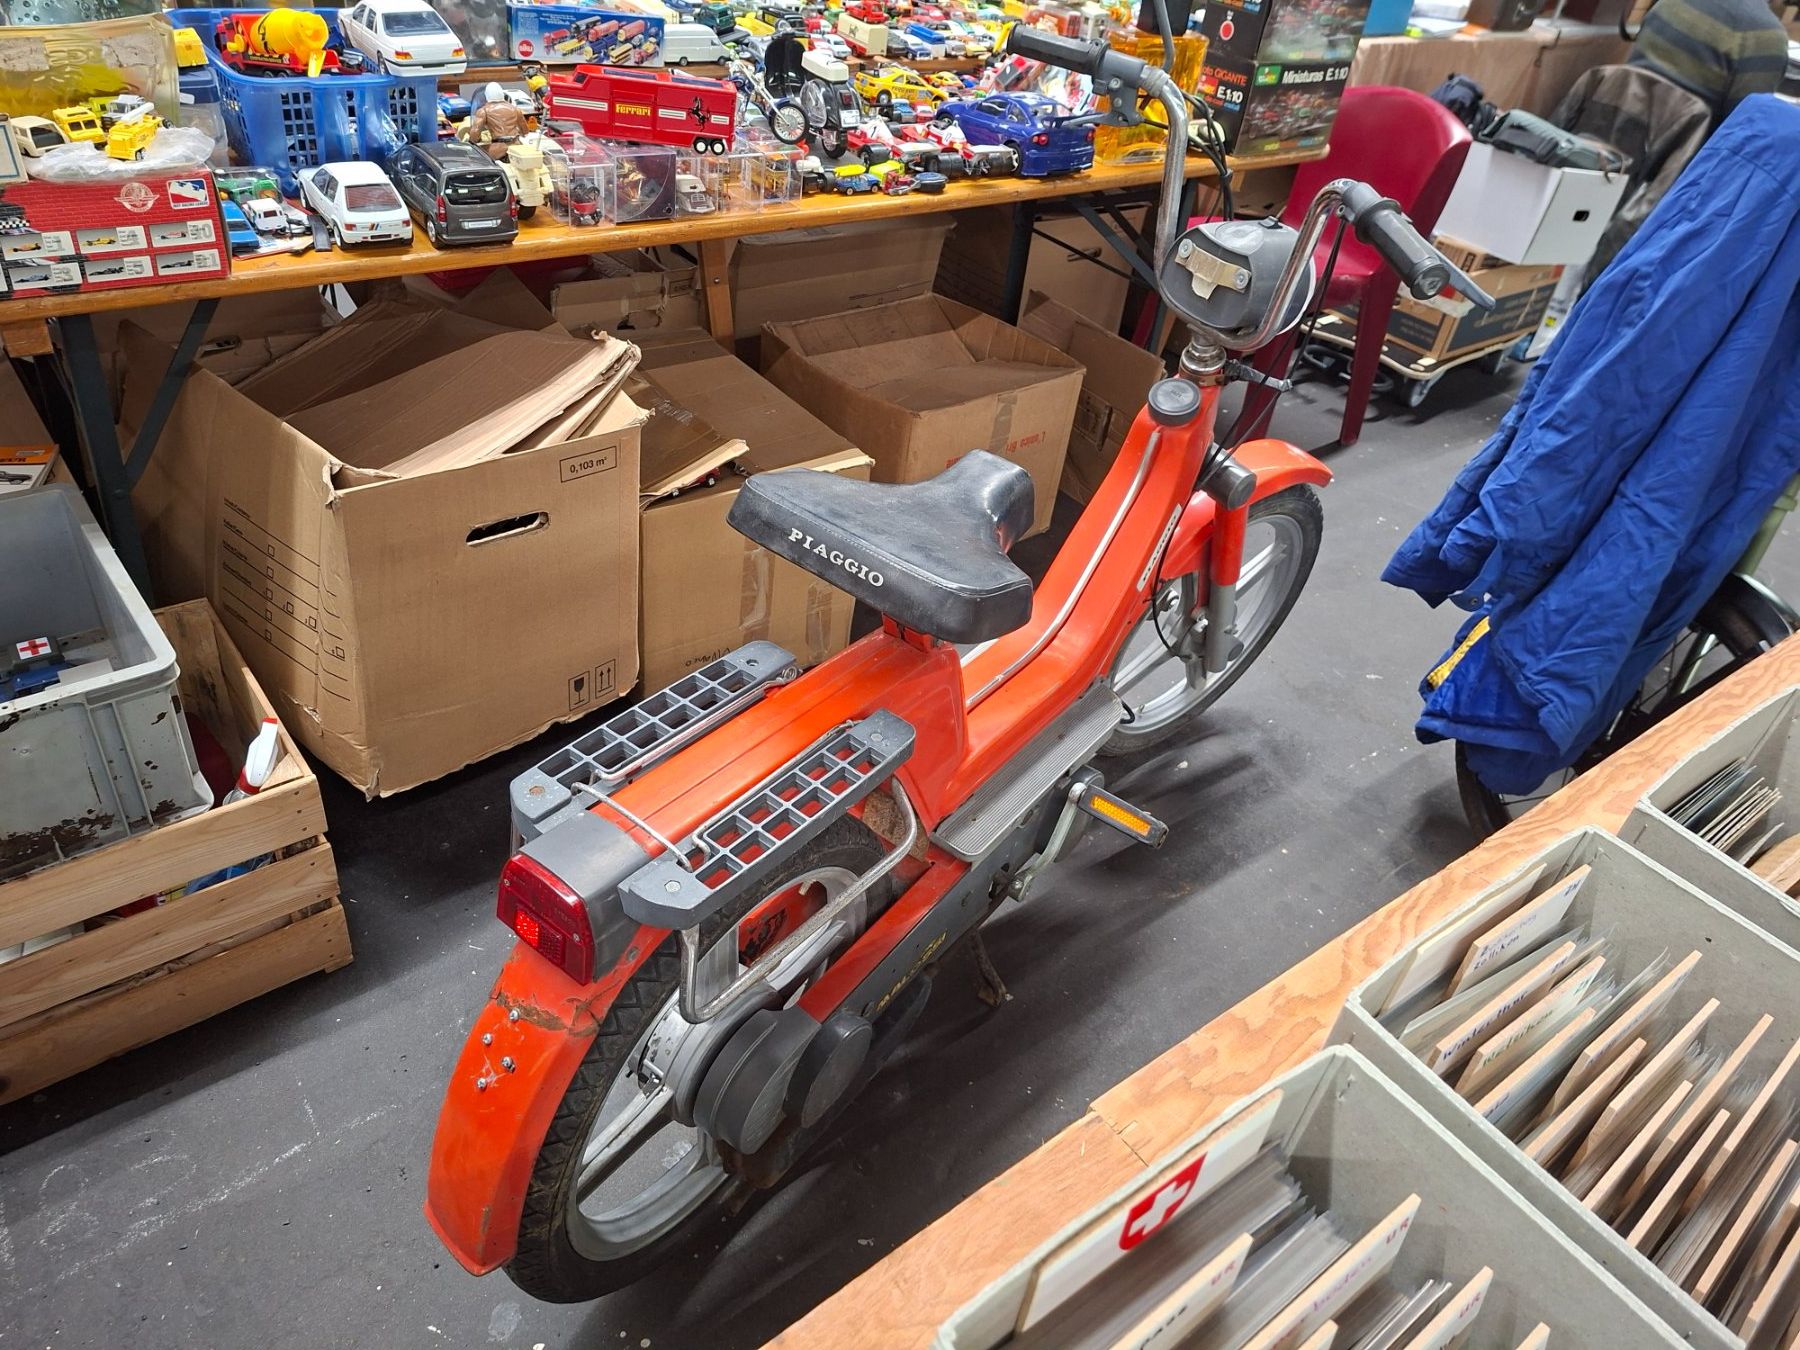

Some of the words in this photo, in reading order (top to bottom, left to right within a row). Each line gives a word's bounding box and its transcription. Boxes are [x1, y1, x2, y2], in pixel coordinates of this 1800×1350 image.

[1214, 67, 1248, 86] GIGANTE
[615, 102, 651, 117] Ferrari
[569, 459, 594, 474] 0,103
[788, 527, 884, 587] PIAGGIO
